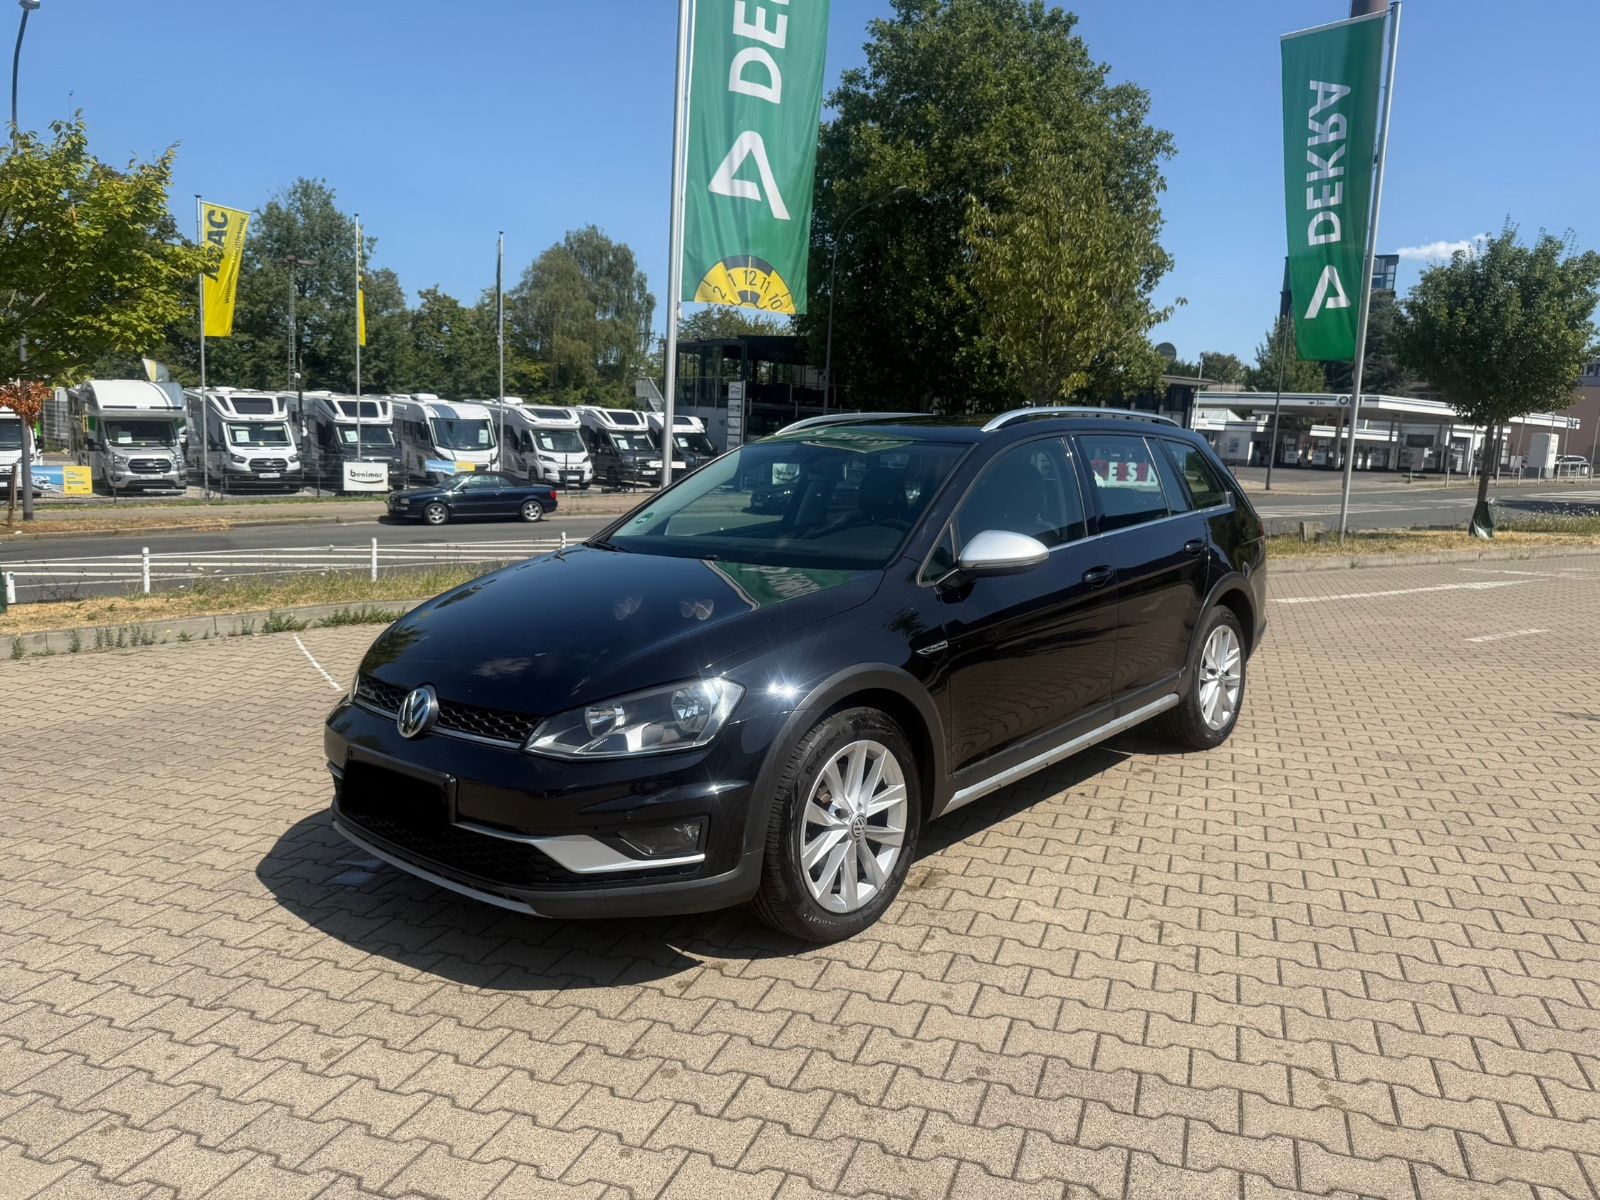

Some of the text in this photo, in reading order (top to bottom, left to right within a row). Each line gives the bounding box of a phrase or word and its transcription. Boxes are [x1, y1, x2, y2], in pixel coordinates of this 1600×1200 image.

[729, 0, 790, 104] DE
[712, 269, 783, 310] 2 1 12 11 10
[350, 469, 383, 478] benimar
